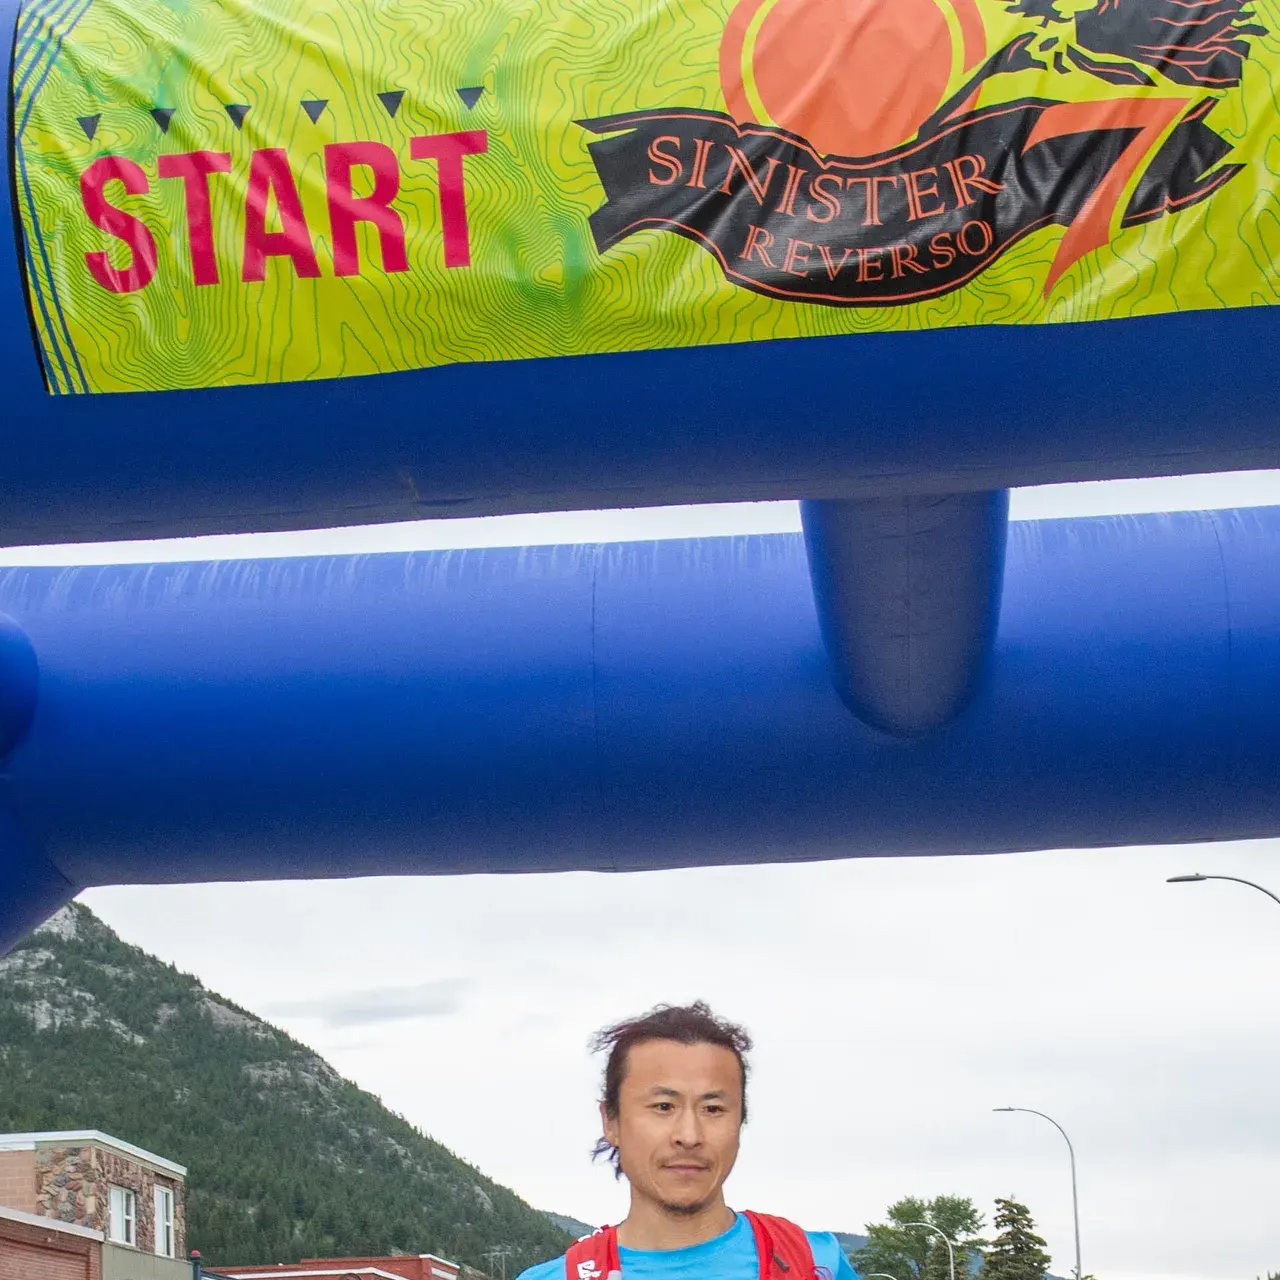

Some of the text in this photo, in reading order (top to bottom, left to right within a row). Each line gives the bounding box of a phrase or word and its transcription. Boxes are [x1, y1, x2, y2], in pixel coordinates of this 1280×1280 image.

[79, 130, 488, 294] START
[646, 135, 1006, 227] SINISTER
[739, 219, 994, 284] REVERSO
